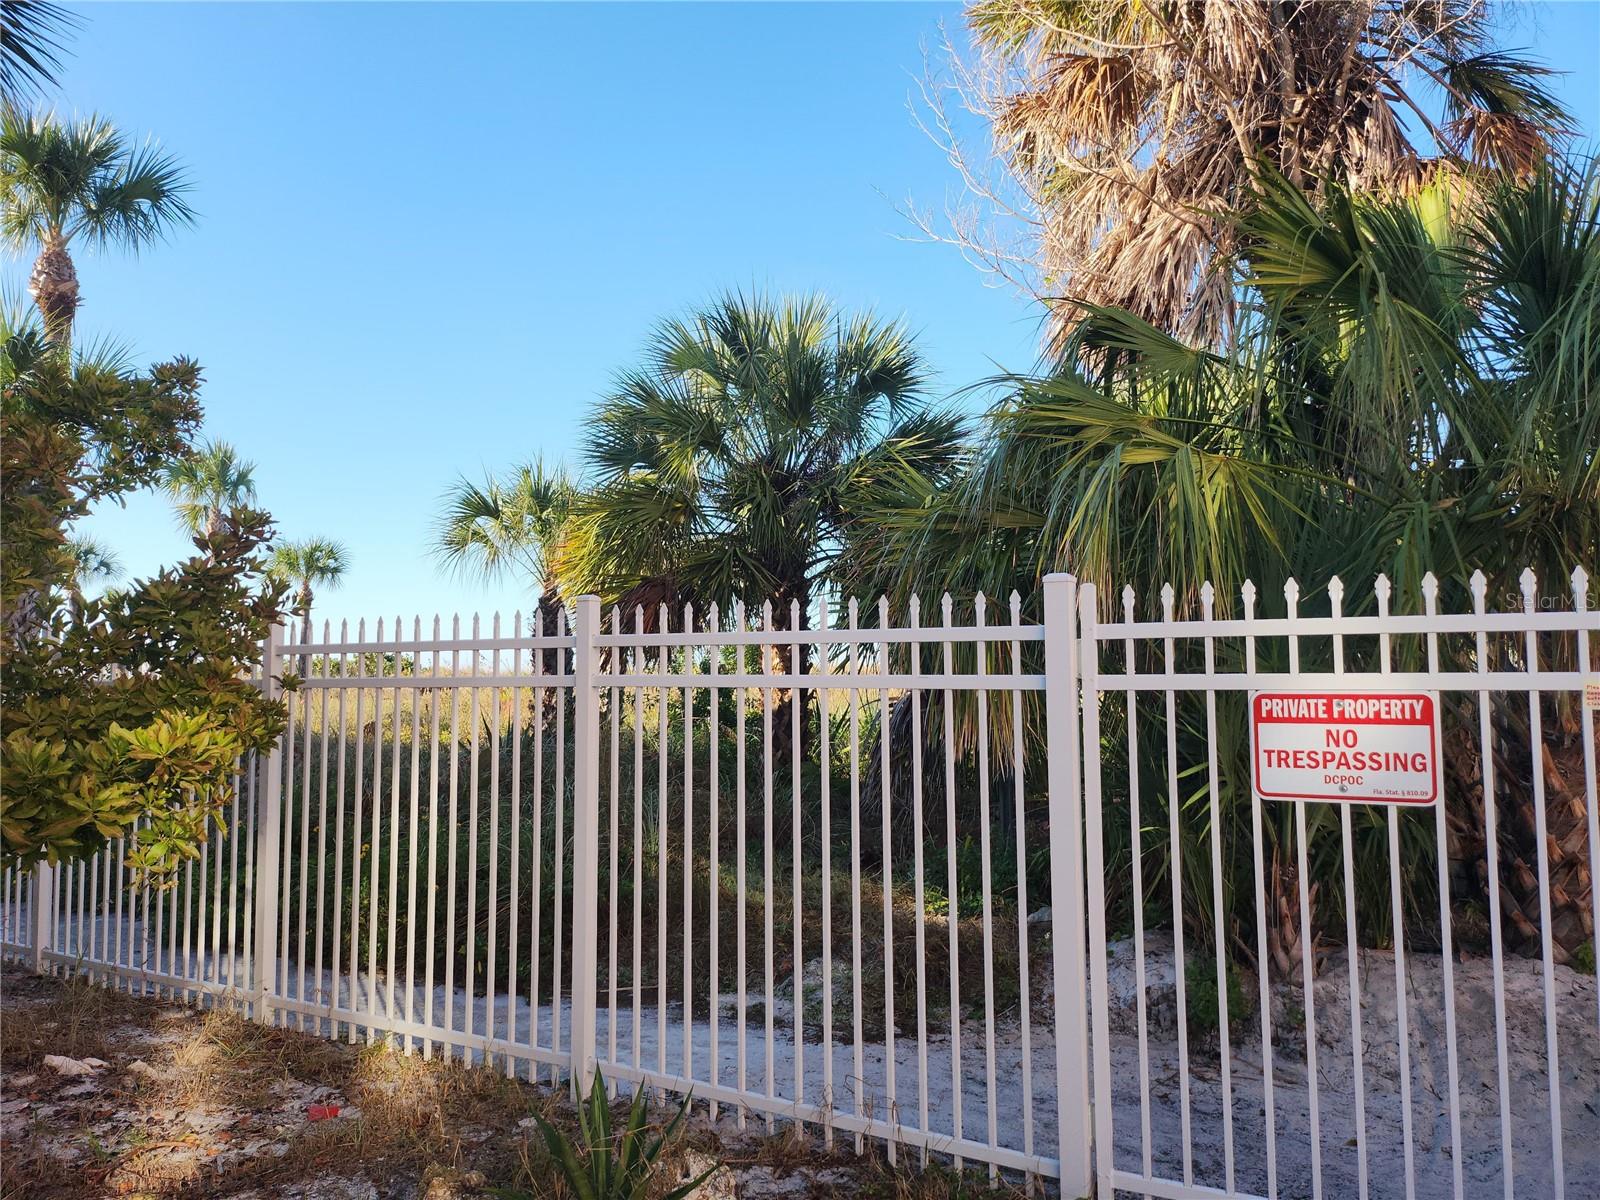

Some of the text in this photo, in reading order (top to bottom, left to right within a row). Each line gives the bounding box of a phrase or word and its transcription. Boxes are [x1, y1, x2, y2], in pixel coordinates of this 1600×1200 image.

[1261, 698, 1424, 720] PRIVATE PROPERTY
[1325, 729, 1358, 749] NO
[1263, 749, 1428, 773] TRESPASSING
[1324, 774, 1364, 786] DCPOC
